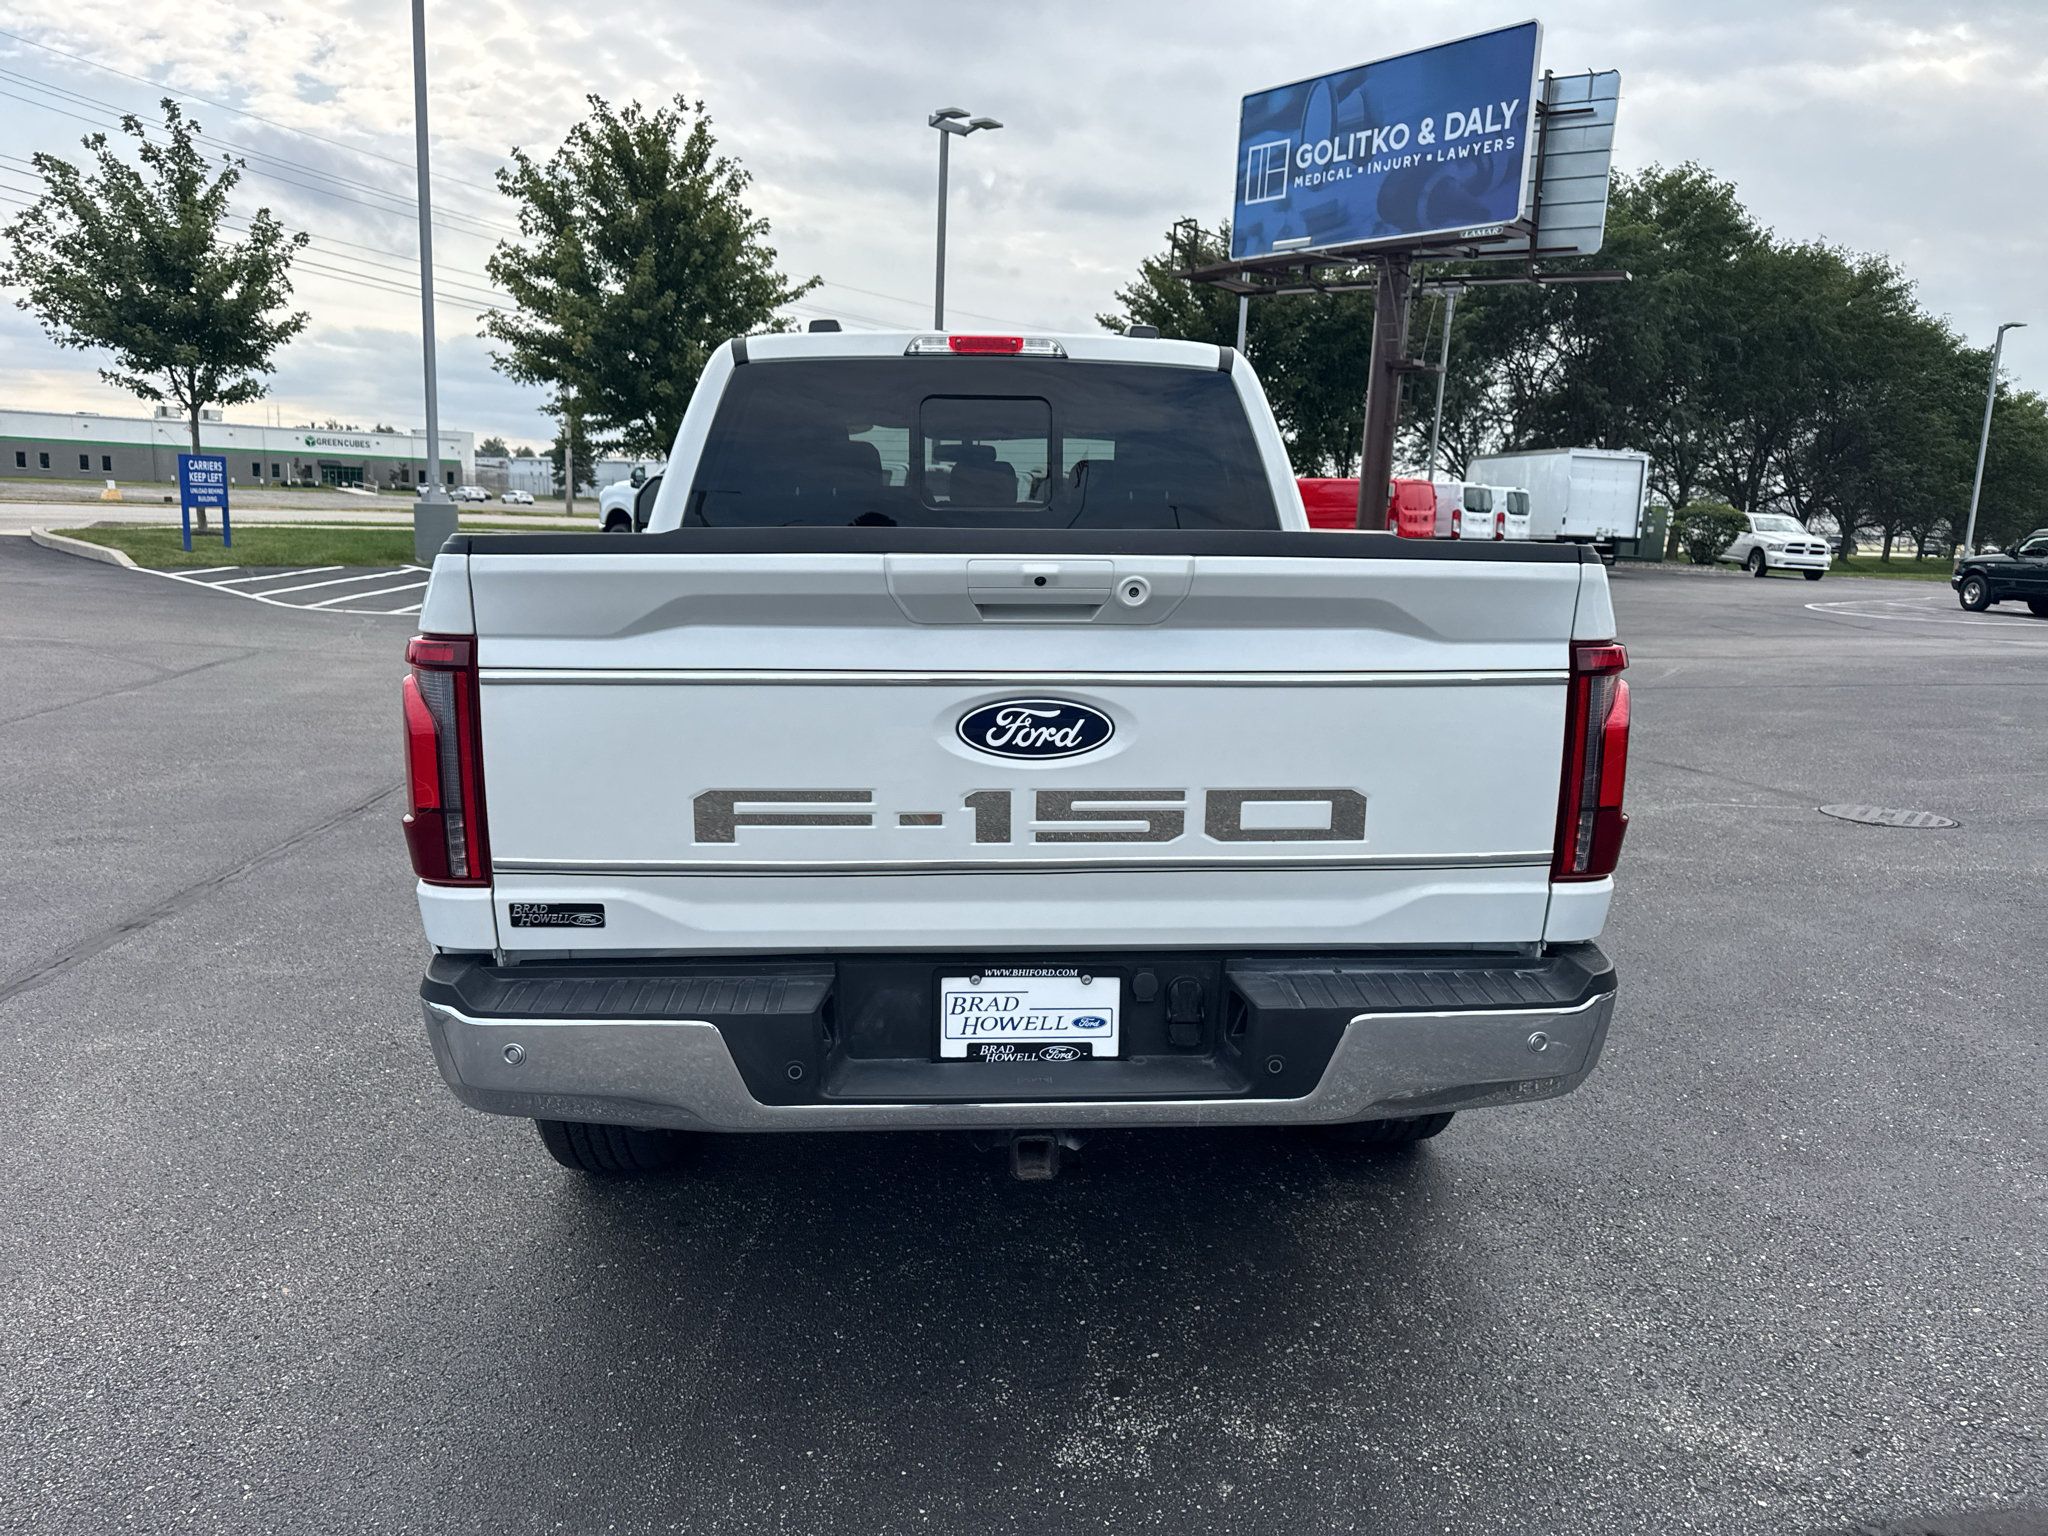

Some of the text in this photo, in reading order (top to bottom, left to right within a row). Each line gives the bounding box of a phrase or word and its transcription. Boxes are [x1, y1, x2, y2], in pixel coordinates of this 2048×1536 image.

[1295, 98, 1520, 169] GOLITKO & DALY
[1293, 136, 1516, 189] MEDICAL INJURY LAWYERS
[1464, 227, 1499, 238] LAMAR
[188, 460, 223, 471] CARRIERS
[188, 472, 223, 483] KEEP LEFT
[190, 487, 224, 495] UNLOAD BEHIND
[197, 495, 218, 503] BUILDING
[985, 707, 1086, 748] Ford
[693, 789, 1368, 844] F-150
[512, 904, 548, 917] BRAD
[518, 914, 571, 926] HOWELL
[984, 968, 1078, 977] WWW.BHIFORD.COM
[949, 996, 1020, 1016] BRAD
[960, 1015, 1101, 1036] HOWELL Ford
[979, 1045, 1015, 1056] BRAD
[985, 1046, 1074, 1063] HOWELL Ford
